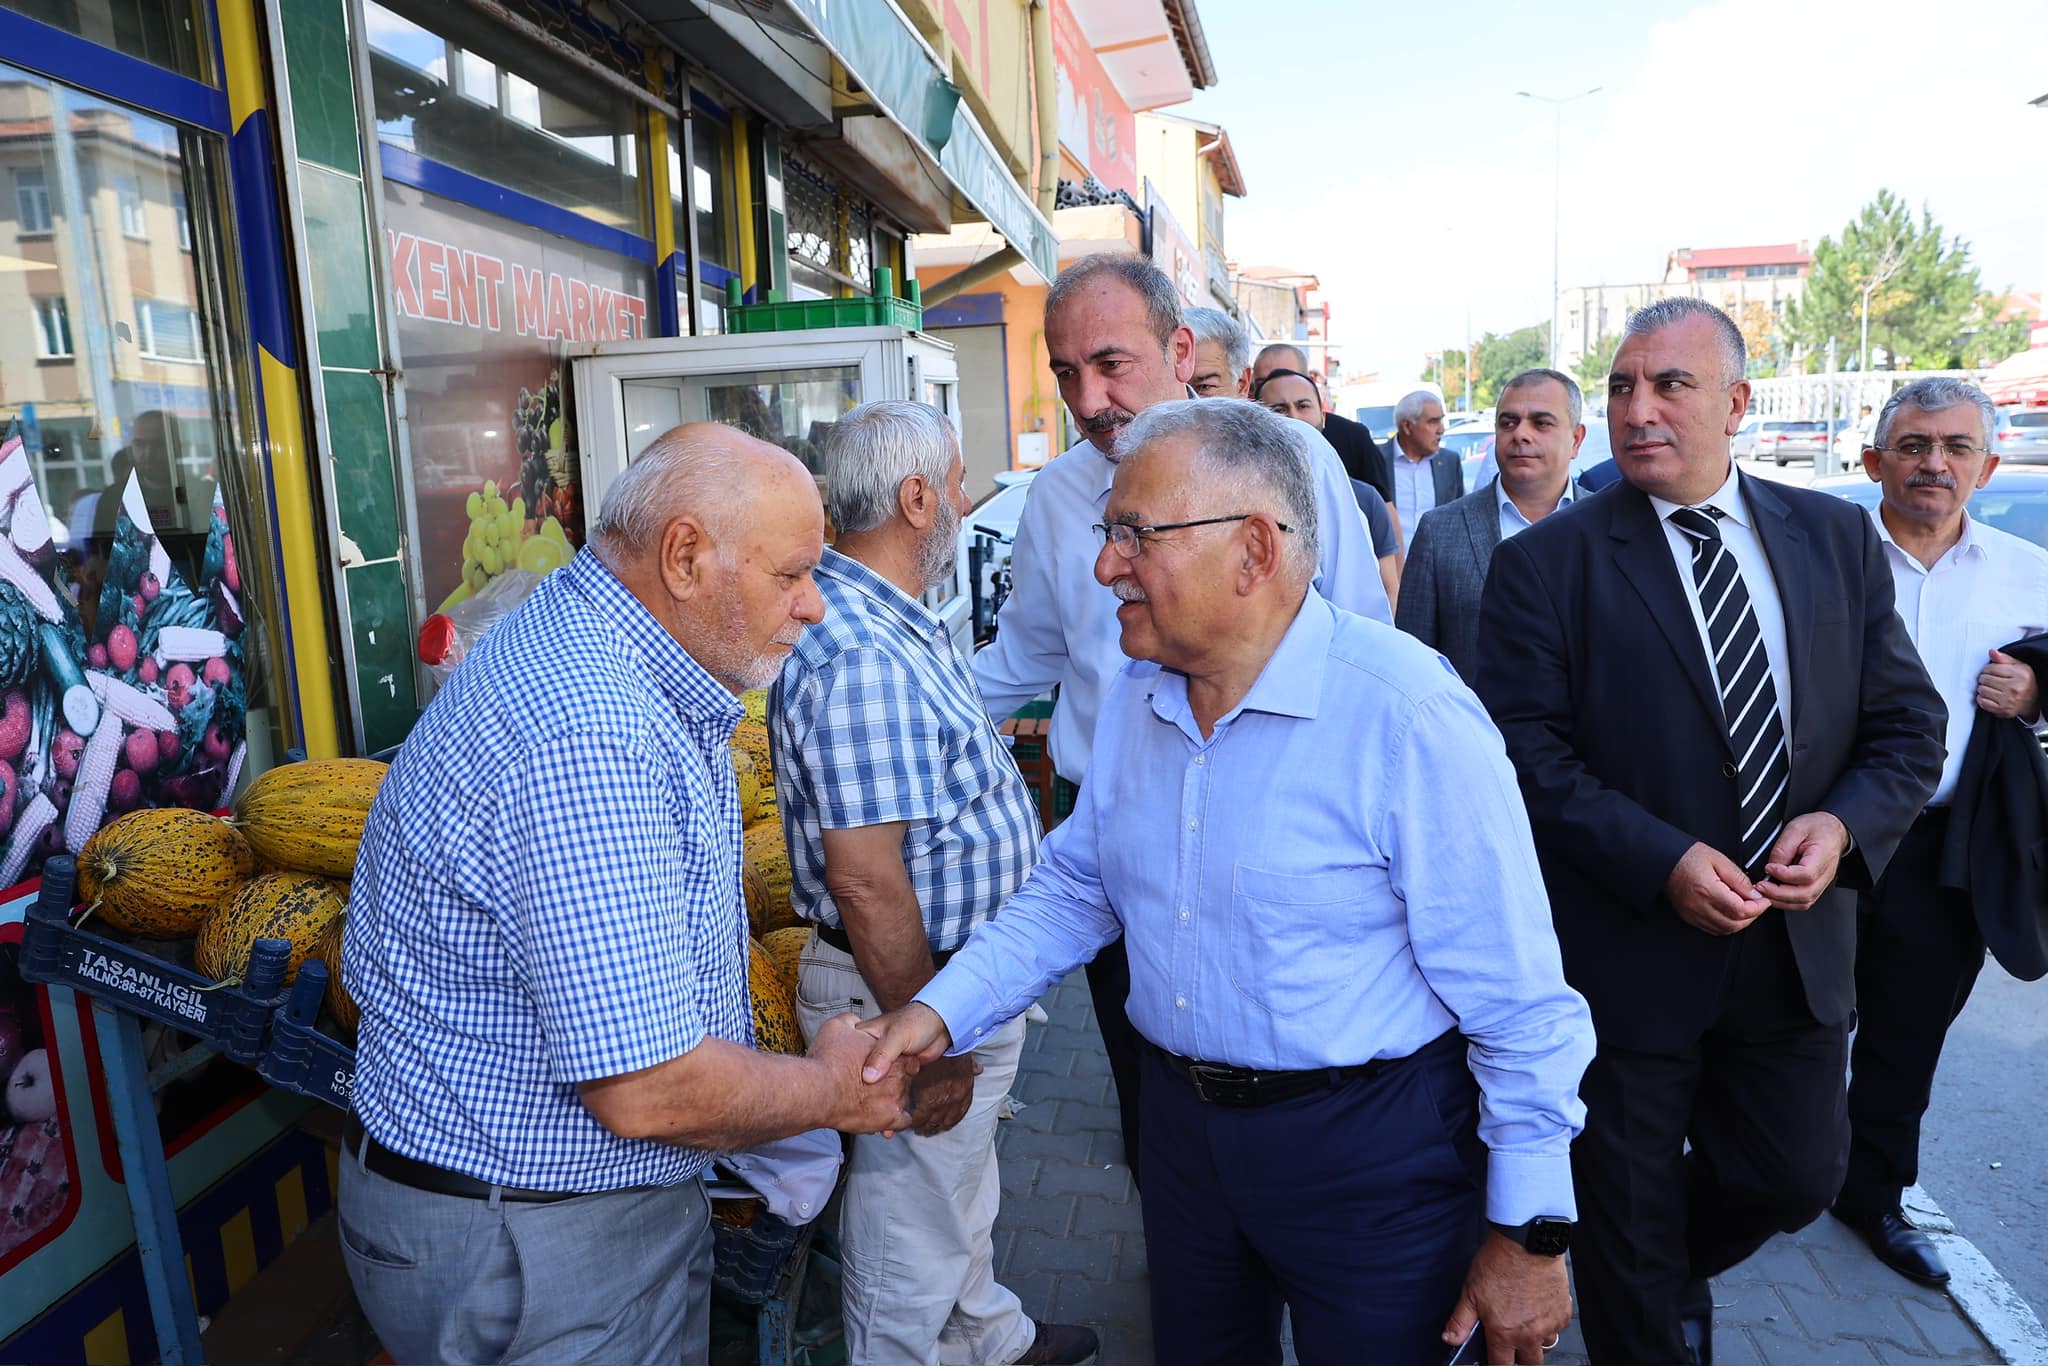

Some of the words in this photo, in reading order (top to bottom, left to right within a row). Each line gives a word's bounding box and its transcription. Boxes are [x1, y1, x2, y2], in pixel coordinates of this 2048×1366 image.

[388, 230, 504, 331] KENT
[512, 264, 646, 341] MARKET
[154, 991, 207, 1024] KAYSERİ
